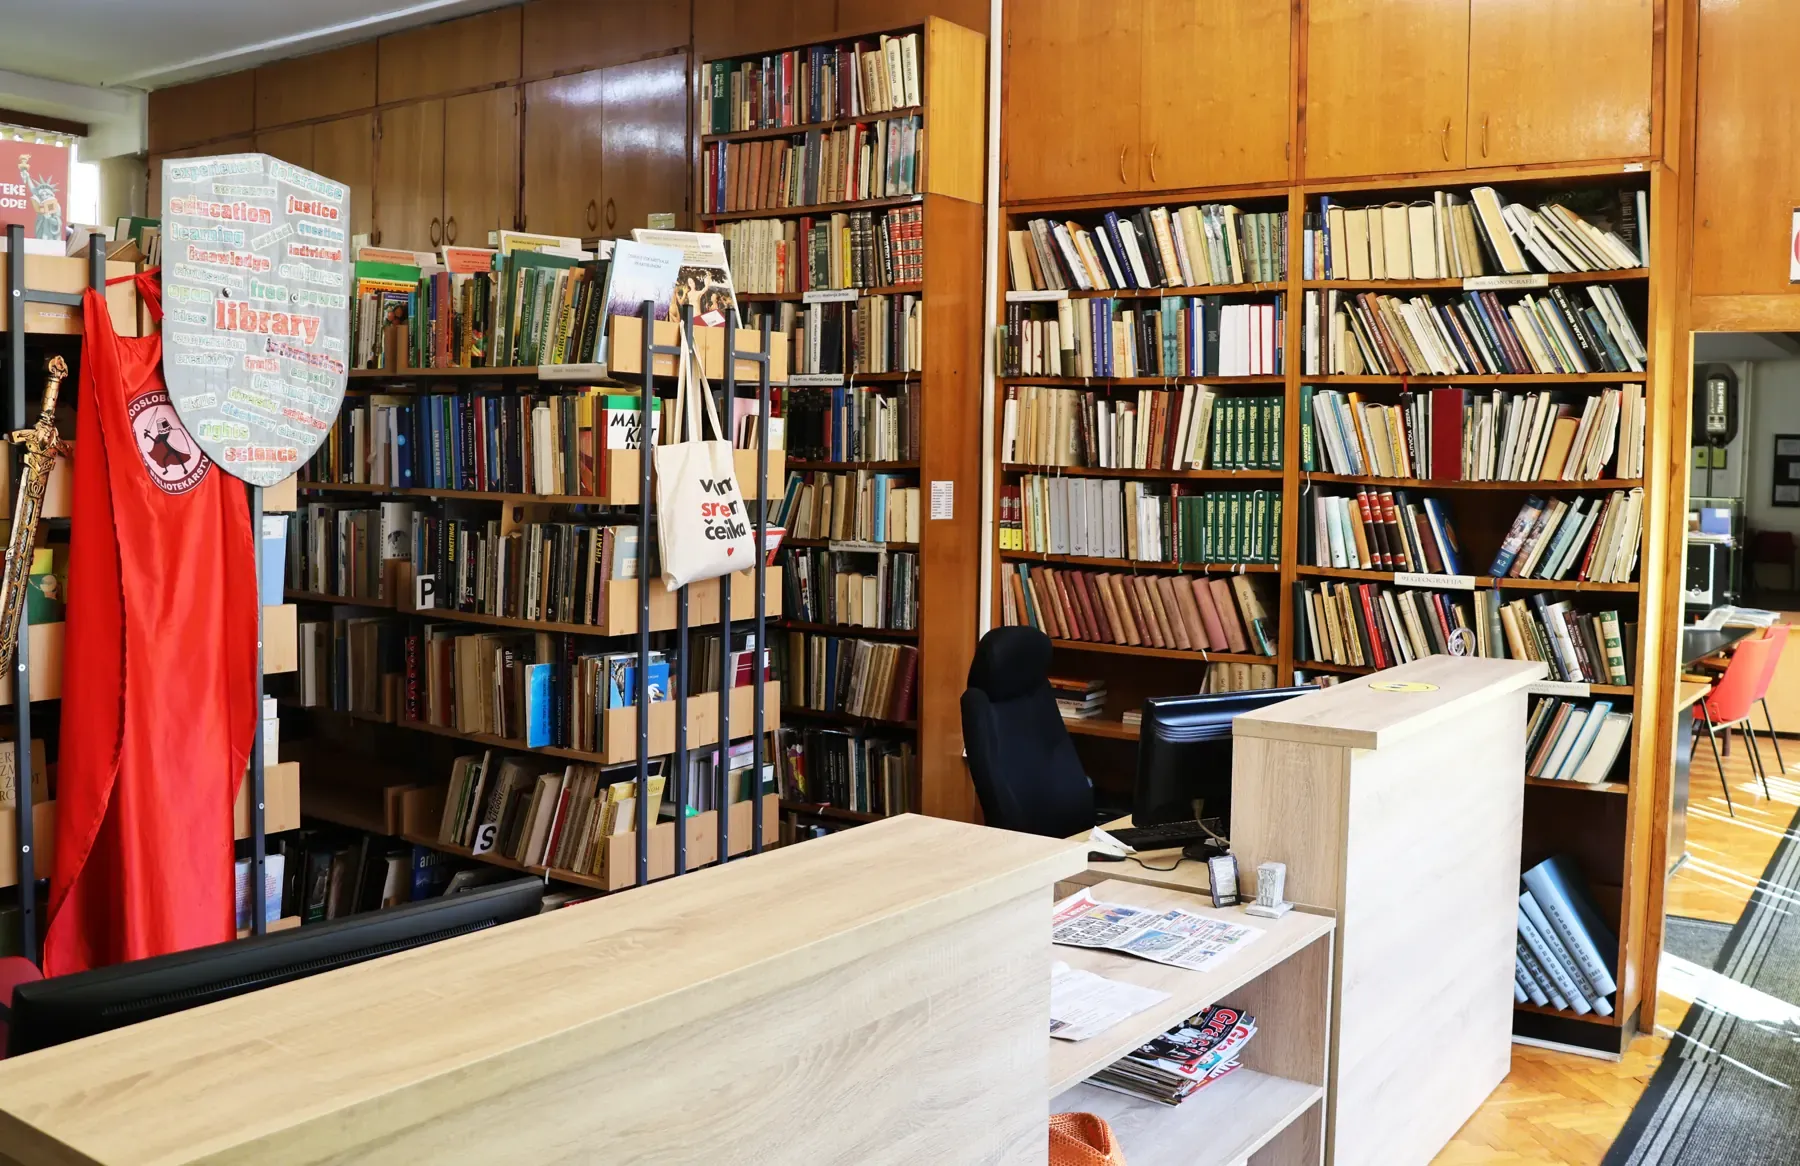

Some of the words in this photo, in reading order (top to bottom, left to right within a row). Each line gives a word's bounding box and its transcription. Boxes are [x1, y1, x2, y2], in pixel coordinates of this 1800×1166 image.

[271, 163, 343, 200] tolerance
[170, 196, 272, 224] education
[287, 196, 338, 219] justice
[172, 224, 243, 245] learning
[299, 223, 344, 241] question
[188, 246, 271, 272] knowledge
[289, 244, 342, 261] individual
[280, 264, 342, 286] cultures
[168, 285, 212, 303] open
[251, 280, 288, 301] free
[300, 290, 344, 306] power
[173, 309, 207, 325] ideas
[216, 300, 320, 345] library
[244, 356, 280, 373] truth
[290, 367, 336, 388] empathy
[253, 374, 338, 411] technology
[199, 421, 249, 441] rights
[277, 425, 317, 445] change
[225, 444, 298, 462] science
[420, 578, 434, 606] P
[480, 825, 496, 850] S
